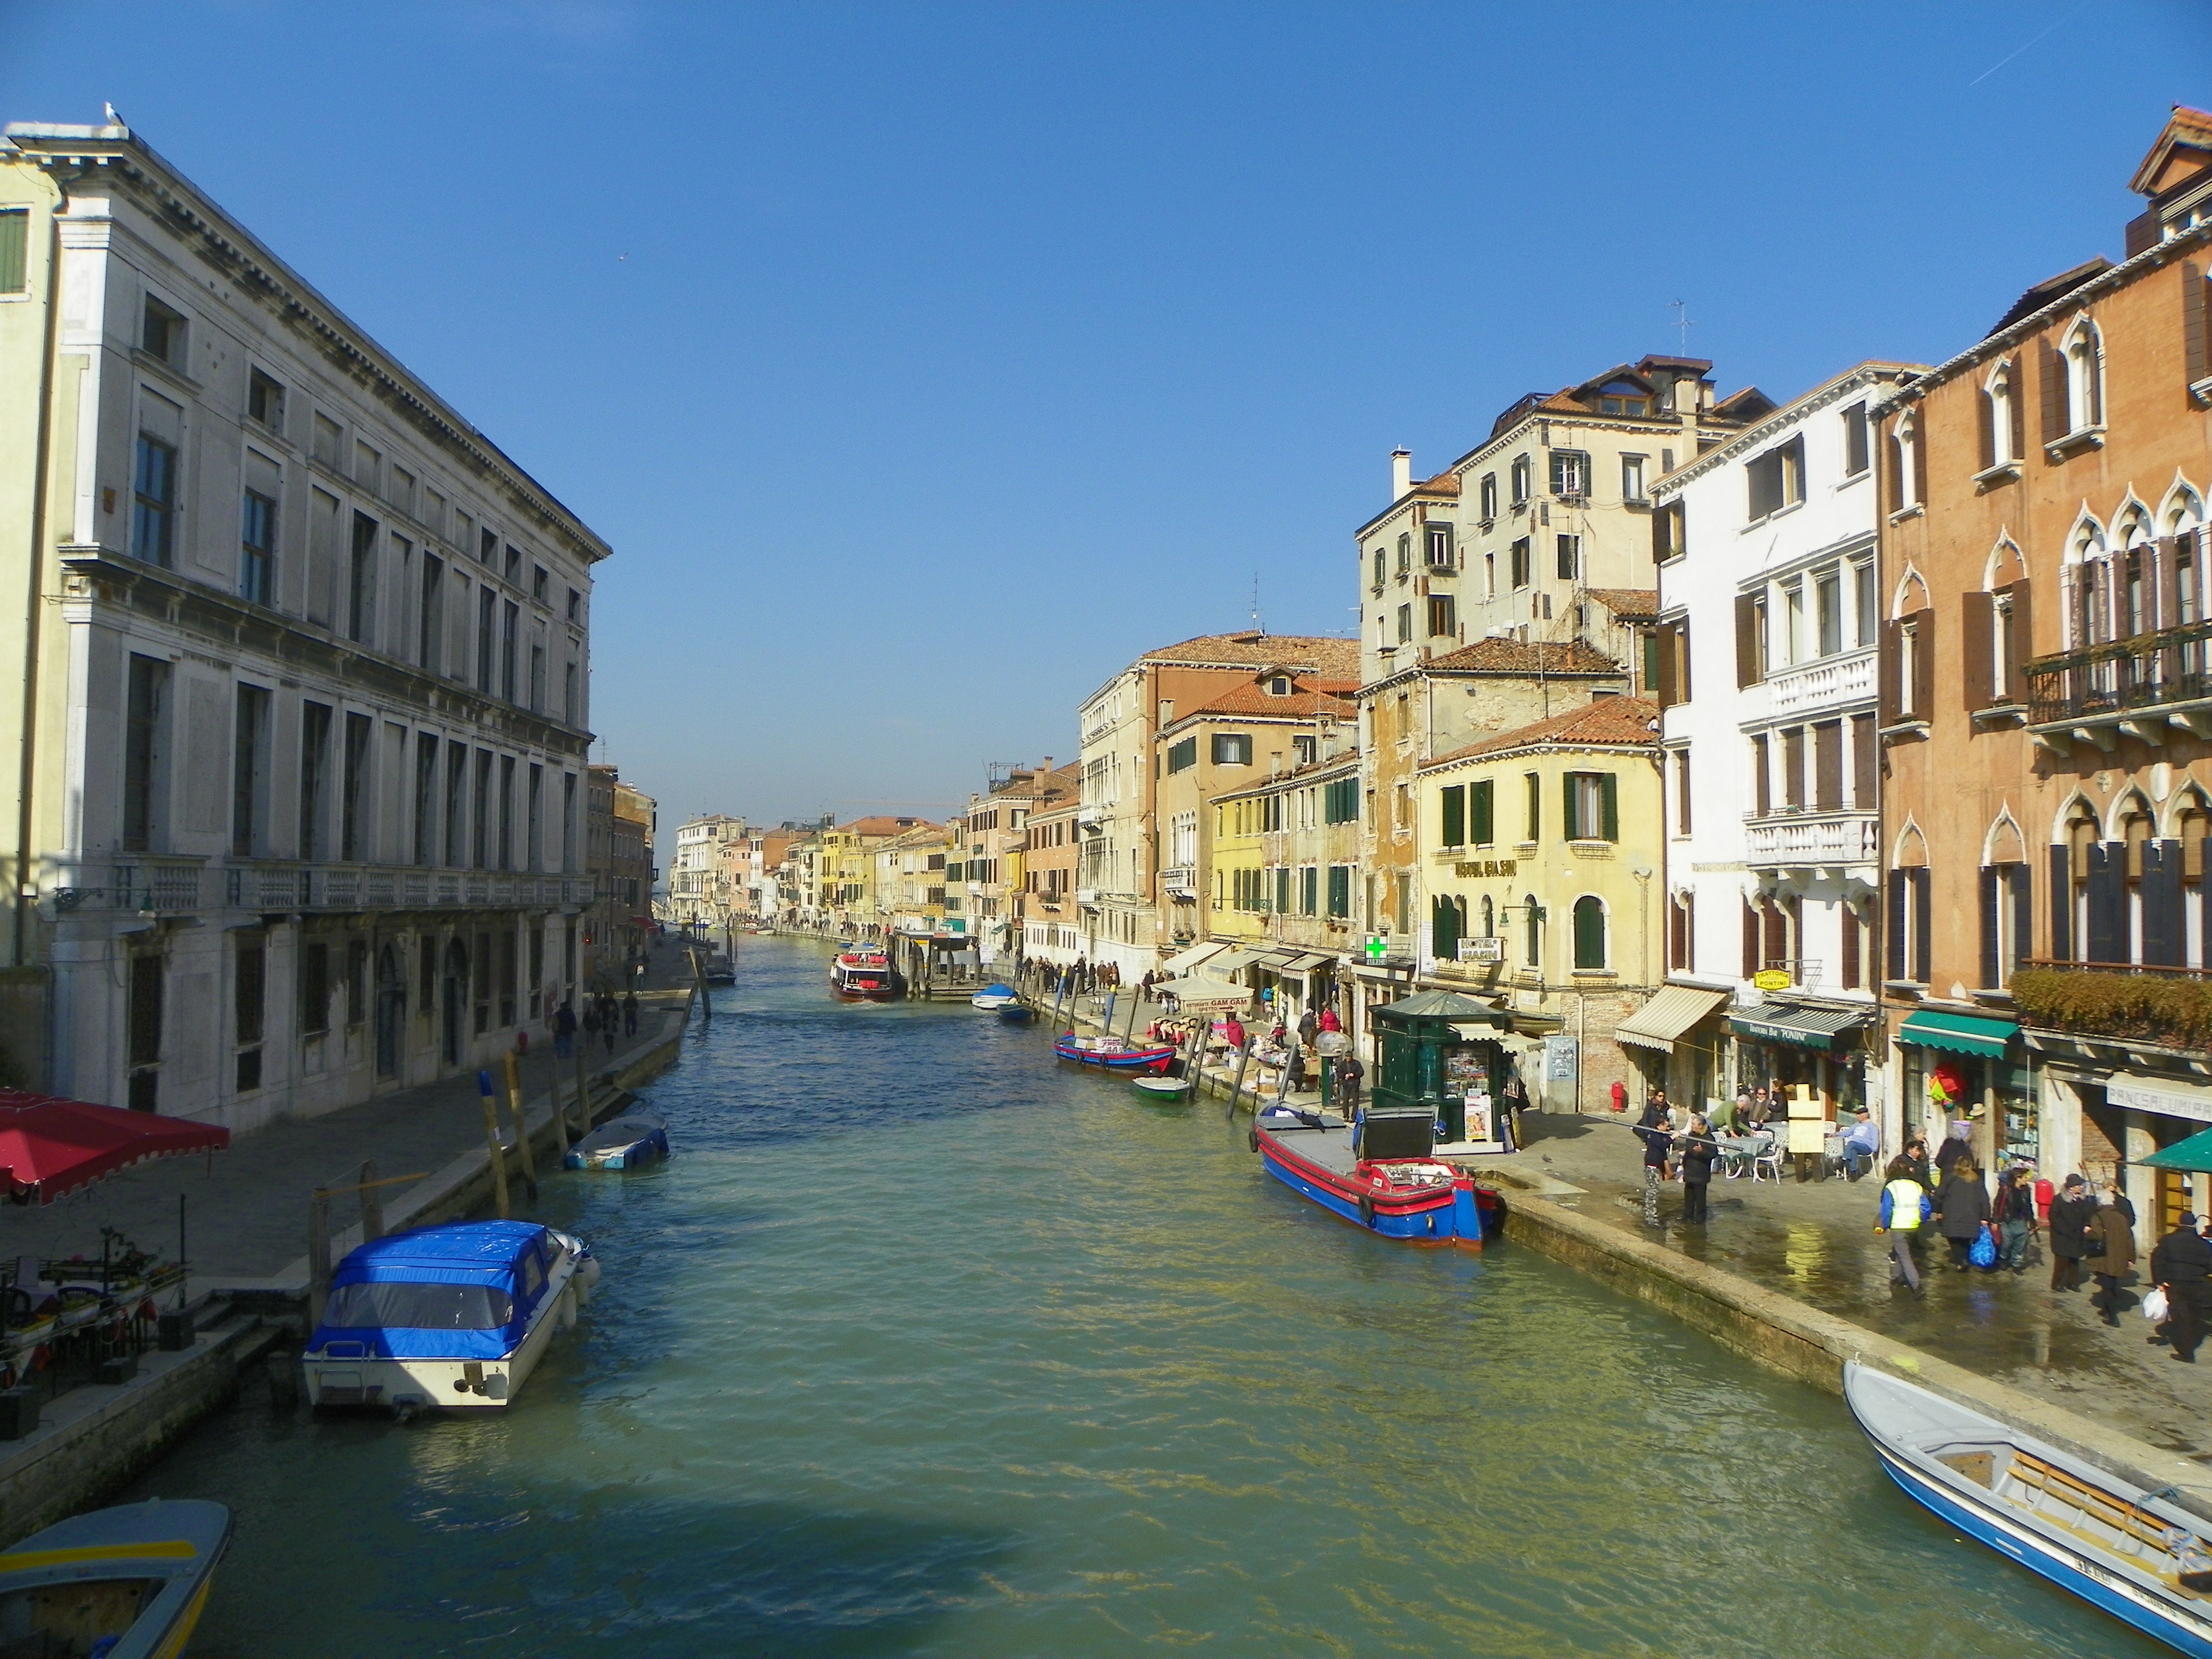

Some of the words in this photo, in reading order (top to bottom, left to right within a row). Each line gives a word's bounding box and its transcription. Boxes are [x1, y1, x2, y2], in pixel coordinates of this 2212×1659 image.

[1485, 860, 1517, 877] BIASIN
[1461, 939, 1494, 949] HOTEL
[1461, 950, 1498, 960] BIASIN
